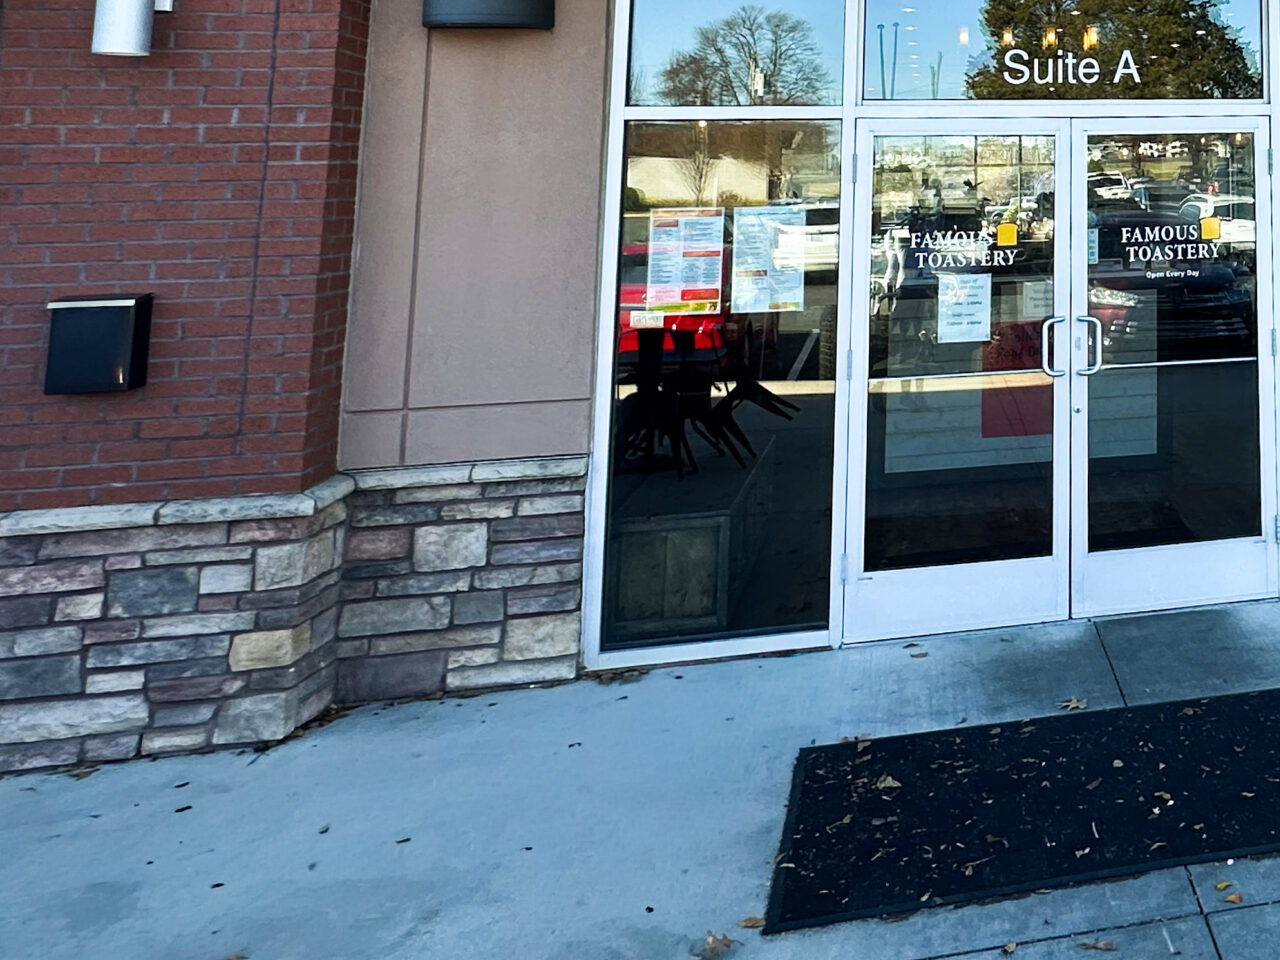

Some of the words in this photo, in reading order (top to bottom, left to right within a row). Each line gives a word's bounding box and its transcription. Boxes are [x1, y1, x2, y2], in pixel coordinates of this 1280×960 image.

[1003, 49, 1100, 85] Suite
[1113, 50, 1142, 84] A
[910, 230, 993, 249] FAMOUS
[1121, 225, 1198, 243] FAMOUS
[915, 249, 1018, 268] TOASTERY
[1126, 243, 1220, 262] TOASTERY
[1146, 271, 1164, 279] Open
[1166, 270, 1185, 278] Every
[1186, 269, 1200, 277] Day
